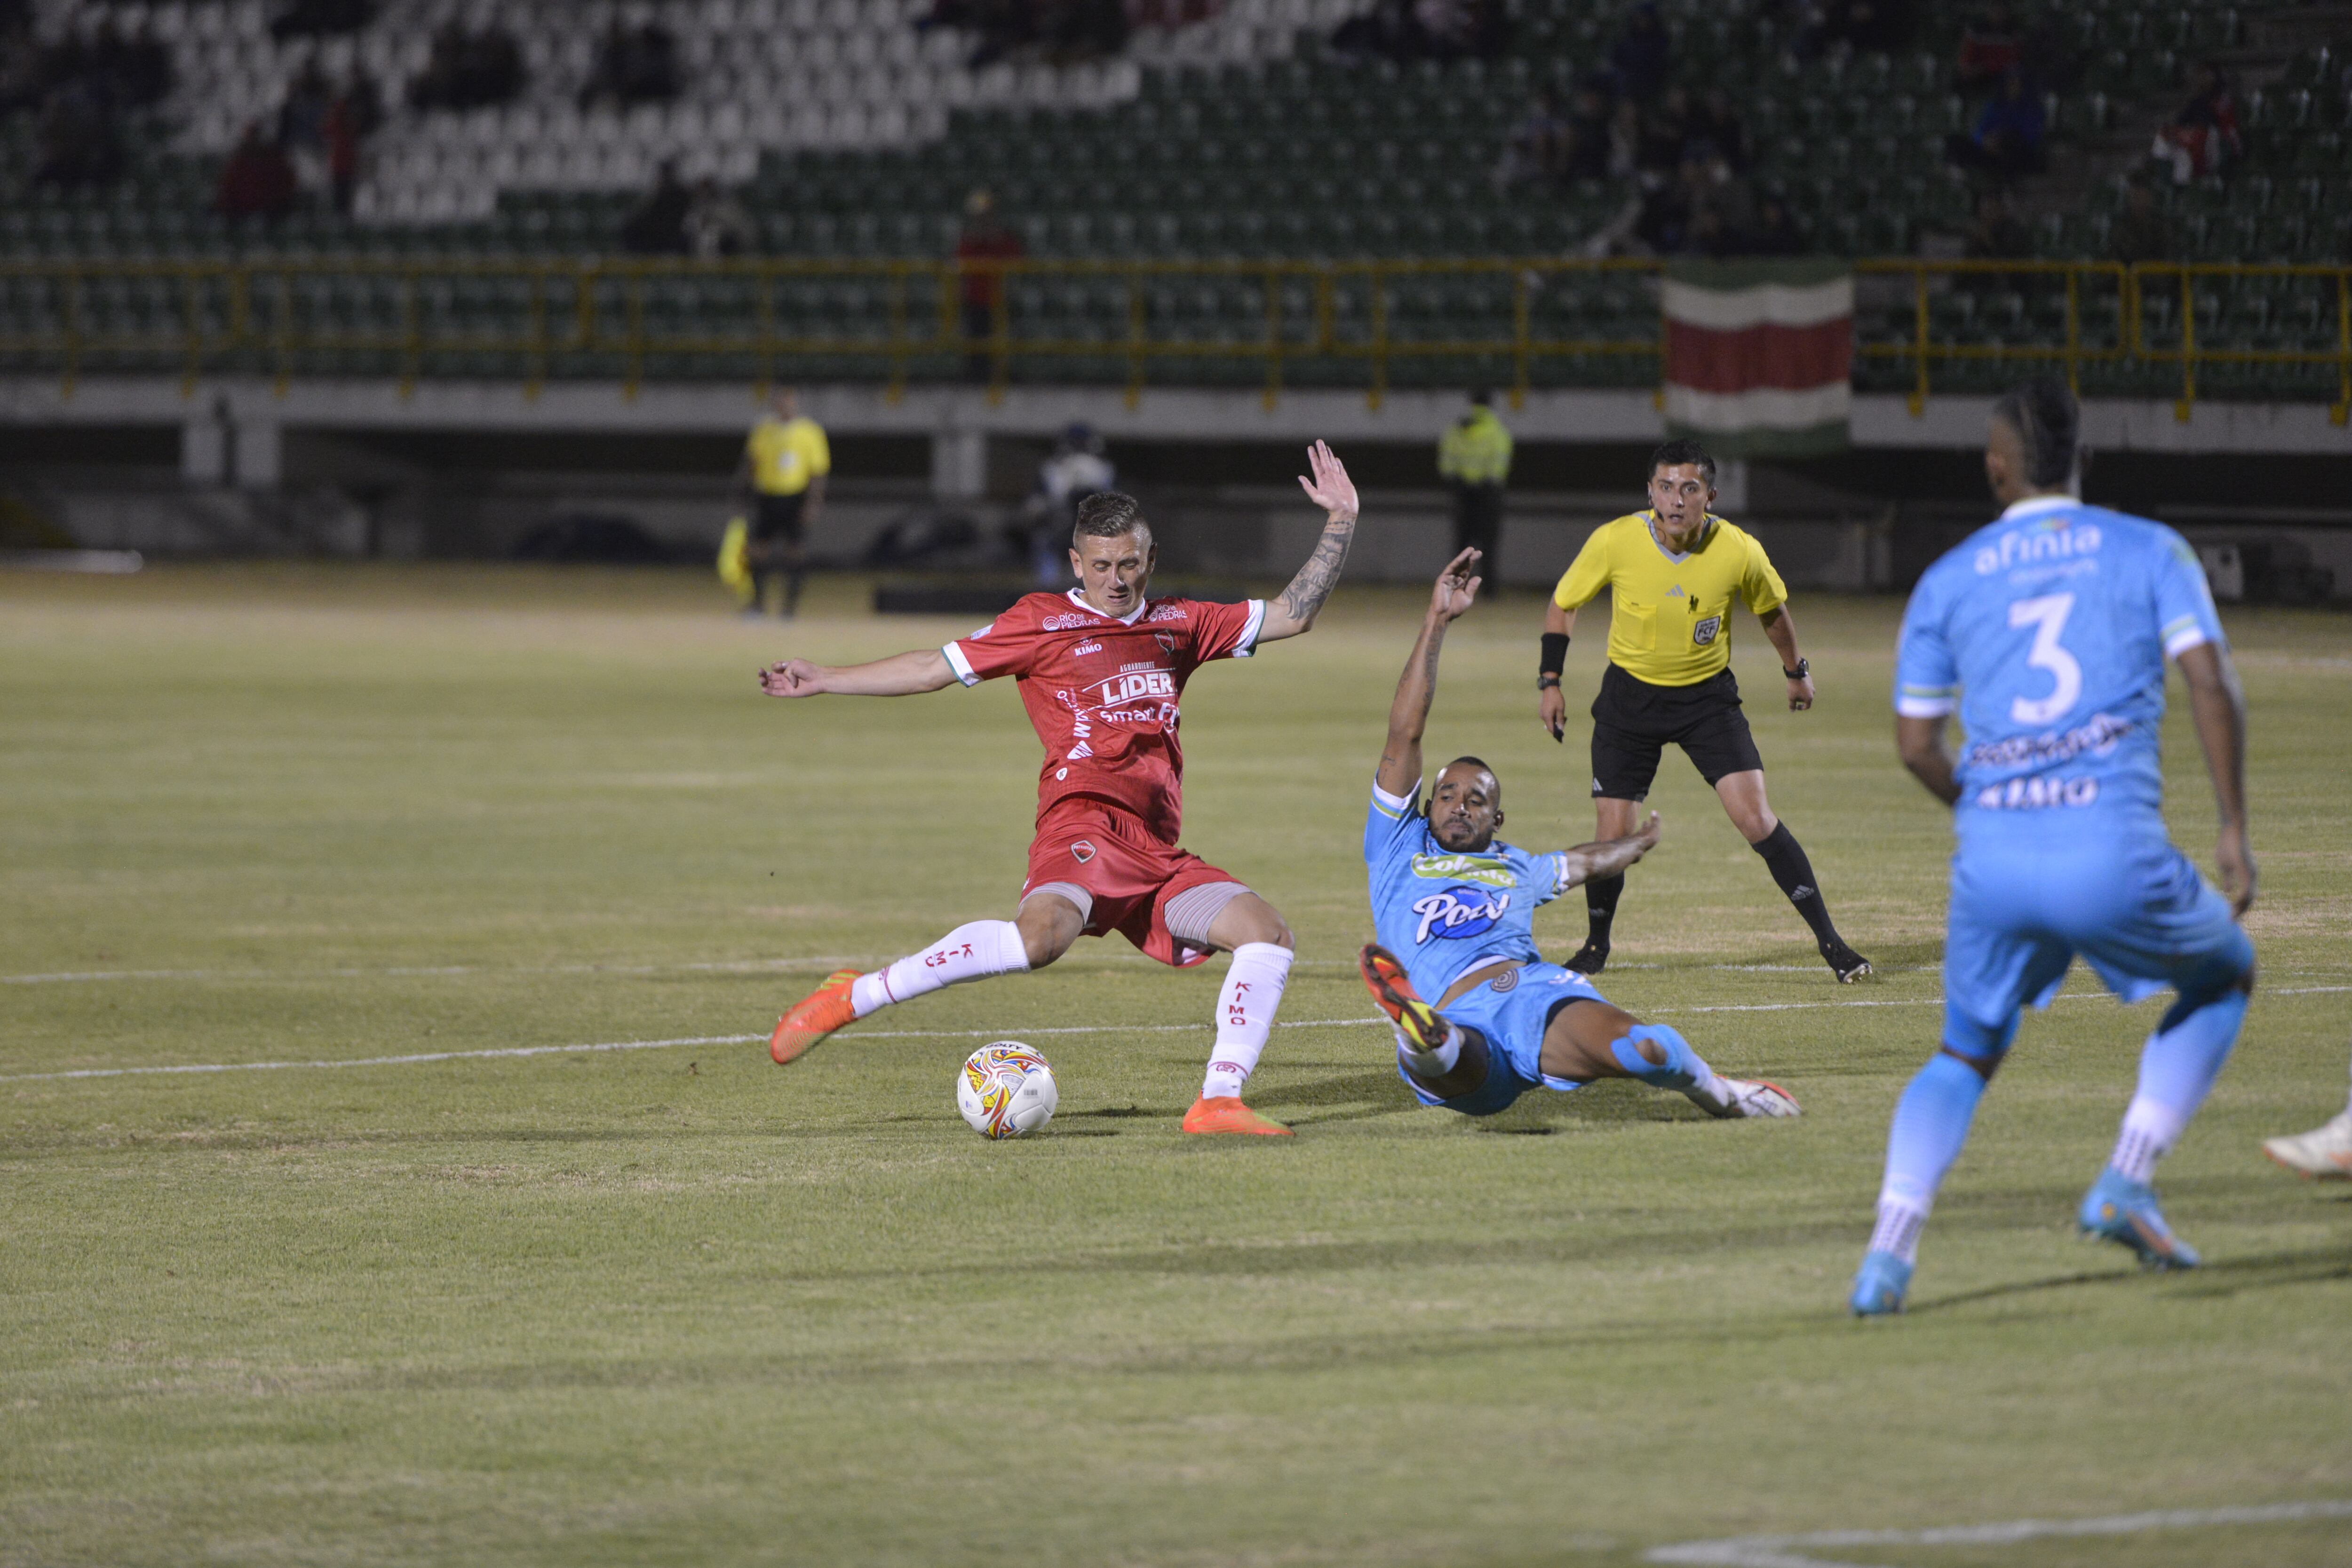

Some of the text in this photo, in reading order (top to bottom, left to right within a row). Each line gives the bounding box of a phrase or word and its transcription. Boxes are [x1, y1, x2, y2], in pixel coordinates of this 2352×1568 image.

[1974, 523, 2102, 575] afinia
[1059, 612, 1076, 623] RÍO
[1158, 610, 1188, 621] PIEDRAS
[1060, 618, 1101, 629] PIEDRAS
[1698, 626, 1716, 636] FCF
[1074, 643, 1103, 657] KIMO
[2009, 592, 2082, 724] 3
[1120, 661, 1155, 673] AGUARDIENTE
[1102, 672, 1174, 705] LÍDER
[1100, 707, 1156, 723] smart
[1229, 981, 1253, 1025] KIMO
